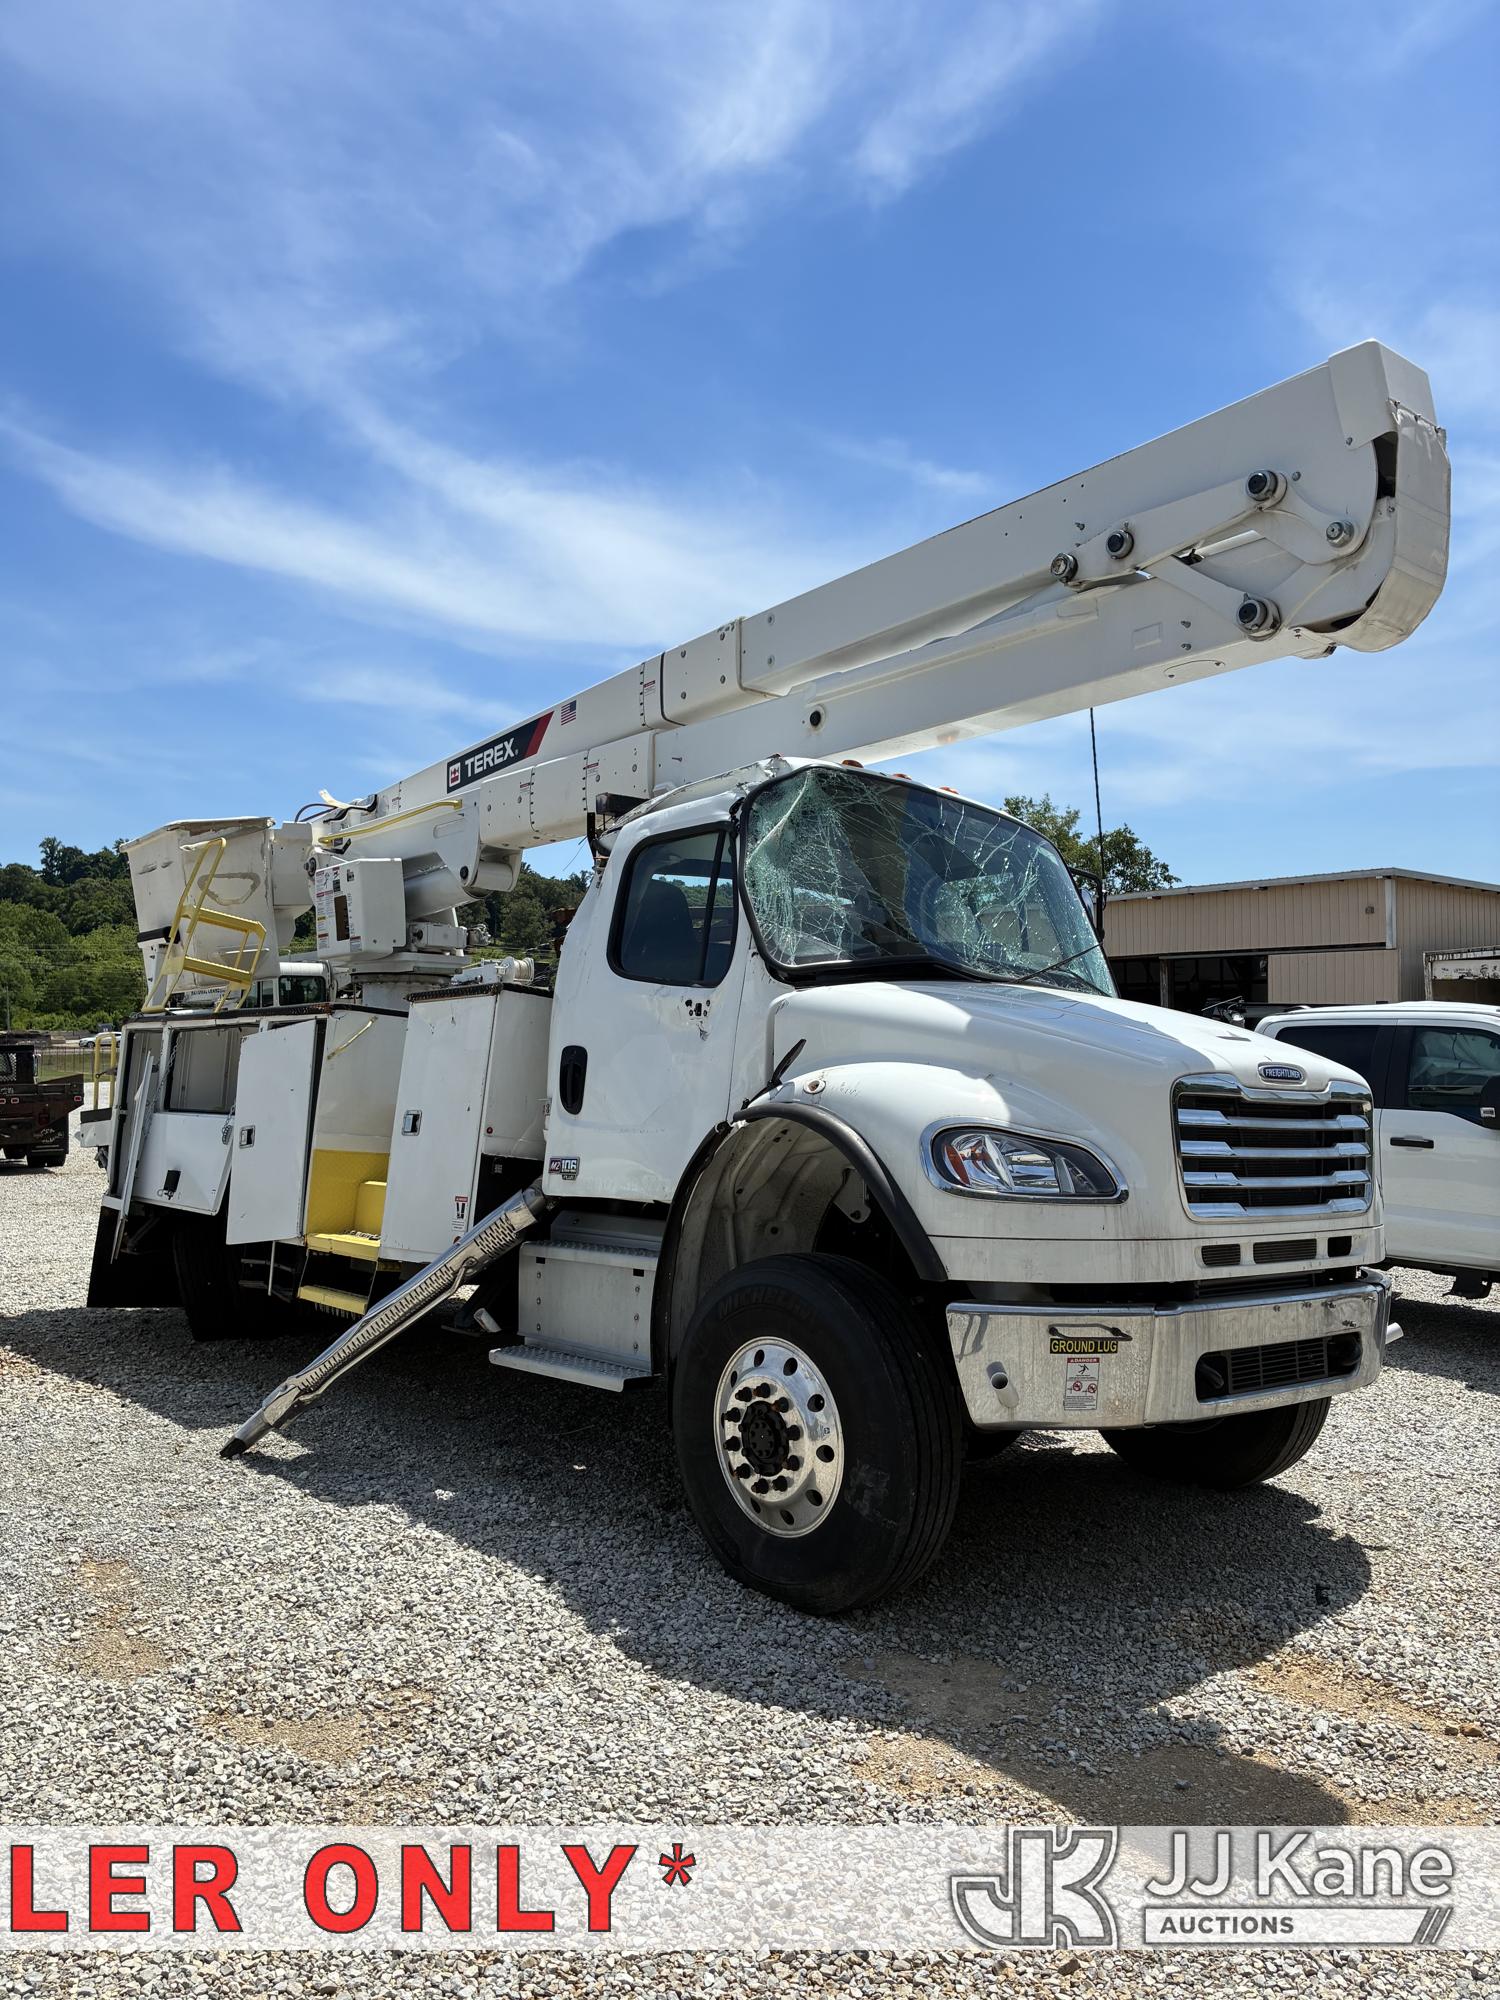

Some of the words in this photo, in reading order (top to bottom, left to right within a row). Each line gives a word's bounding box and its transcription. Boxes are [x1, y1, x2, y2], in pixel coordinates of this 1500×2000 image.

[465, 738, 515, 777] TEREX
[1265, 1068, 1300, 1079] FREIGHTLINER
[551, 1161, 560, 1170] M2
[562, 1160, 577, 1170] 106
[1051, 1340, 1095, 1353] GROUND
[1097, 1340, 1117, 1352] LUG
